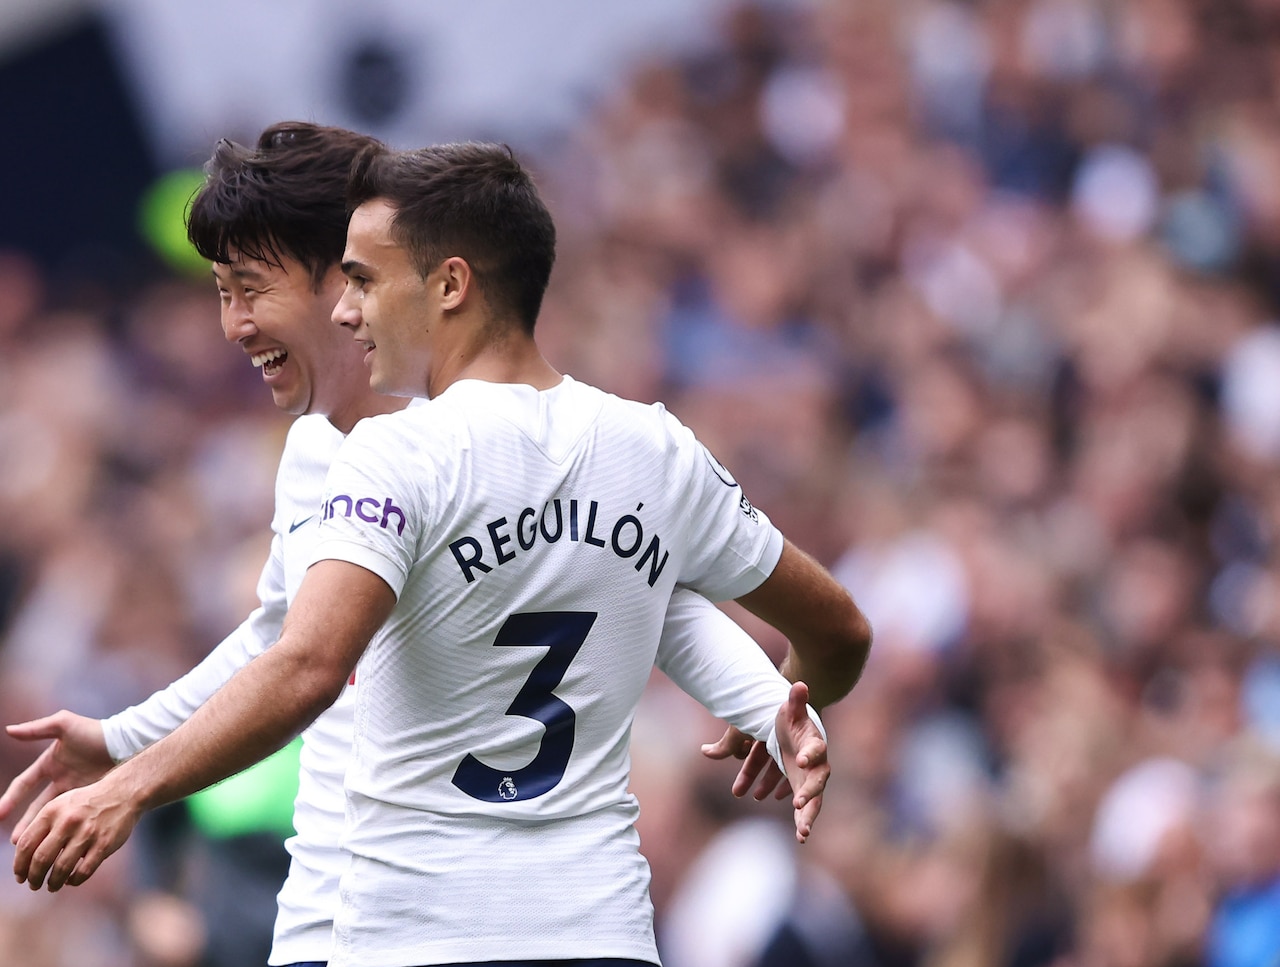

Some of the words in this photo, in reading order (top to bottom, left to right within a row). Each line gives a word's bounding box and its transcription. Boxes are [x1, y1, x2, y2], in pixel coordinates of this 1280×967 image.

[319, 493, 407, 538] inch
[448, 498, 670, 588] REGUILÓN
[450, 611, 599, 804] 3
